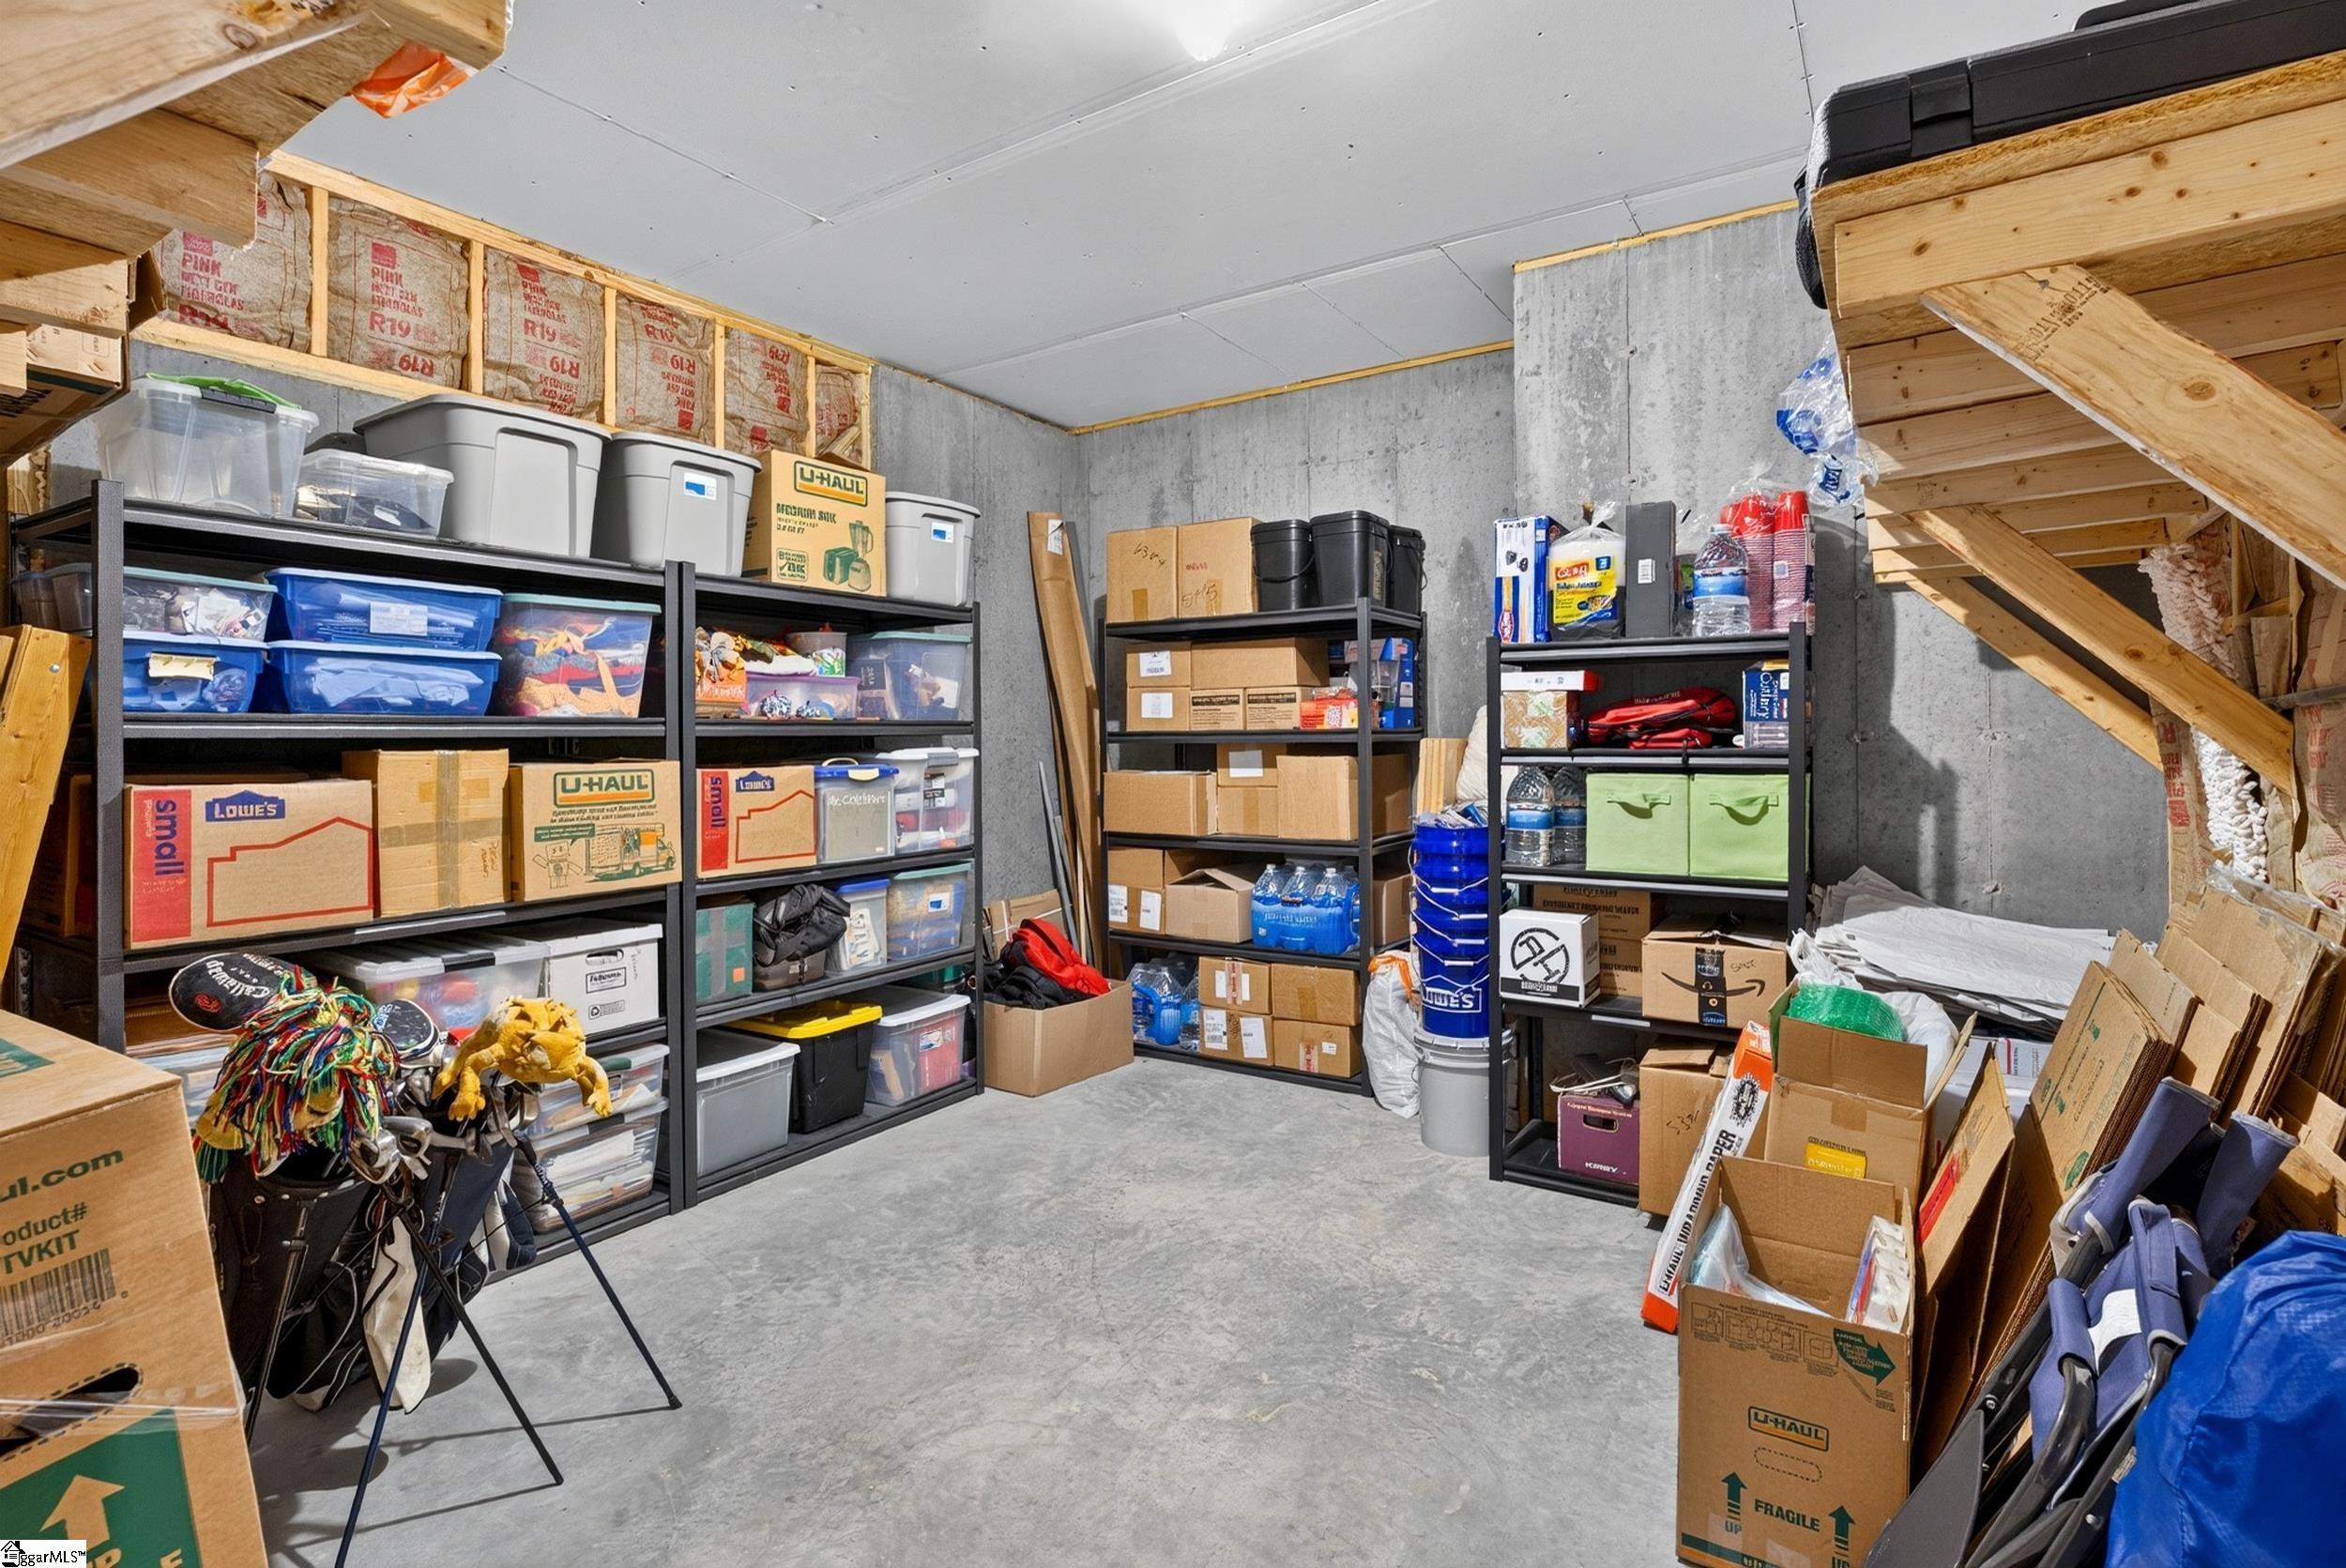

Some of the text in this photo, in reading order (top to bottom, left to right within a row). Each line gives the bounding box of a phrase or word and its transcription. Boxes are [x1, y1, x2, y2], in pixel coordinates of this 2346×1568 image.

[369, 311, 411, 338] R19
[523, 317, 556, 343] R19
[549, 355, 580, 379] R19
[670, 354, 695, 374] R19
[800, 466, 864, 495] U-HAUL
[561, 774, 649, 794] U-HAUL
[214, 801, 278, 819] LOWE'S
[710, 776, 726, 828] small
[155, 799, 185, 876] small
[1753, 1411, 1824, 1441] U-HAUL
[1725, 1520, 1743, 1534] UP
[1755, 1499, 1820, 1532] FRAGILE
